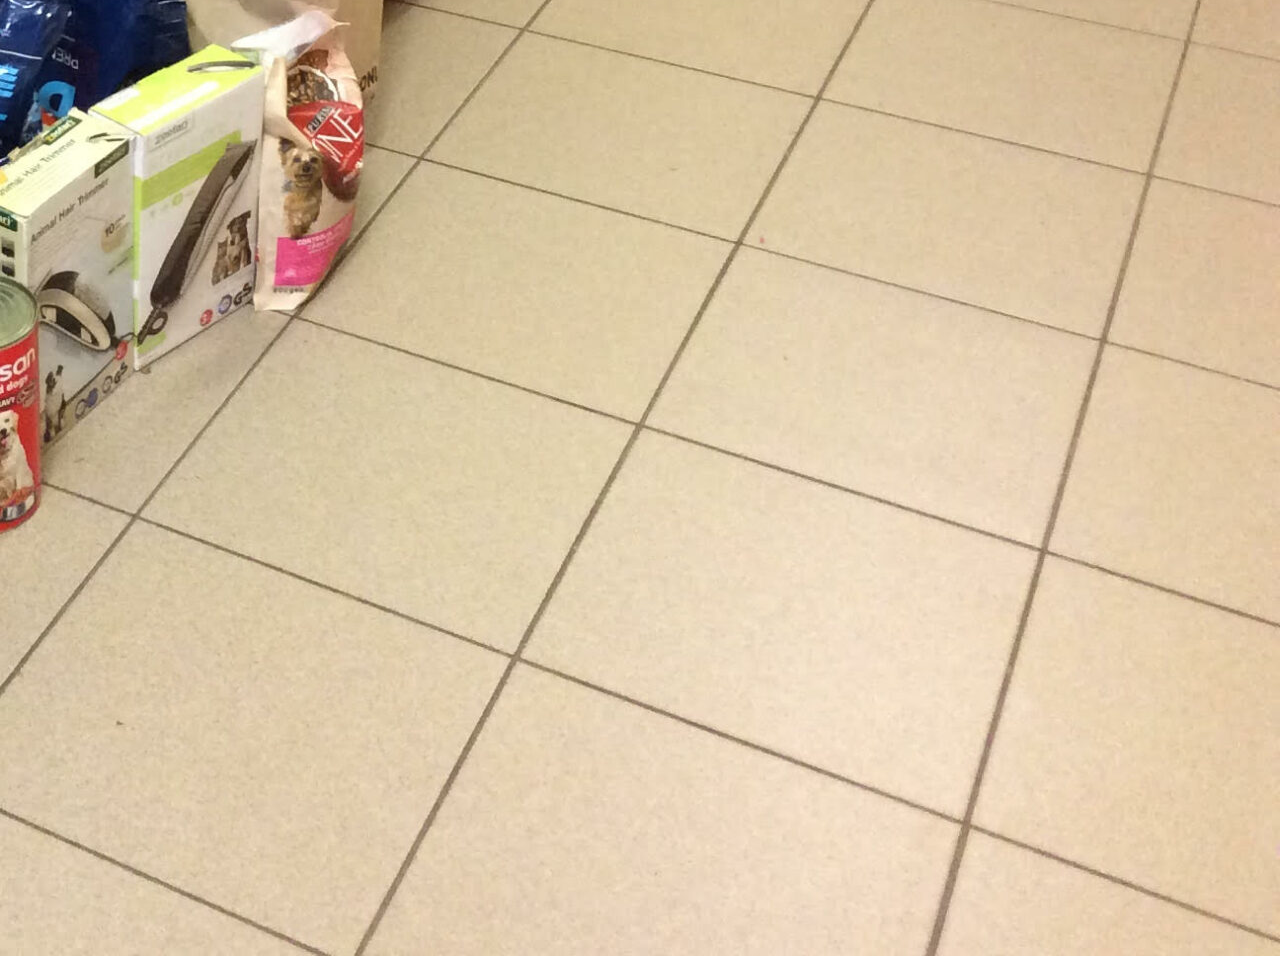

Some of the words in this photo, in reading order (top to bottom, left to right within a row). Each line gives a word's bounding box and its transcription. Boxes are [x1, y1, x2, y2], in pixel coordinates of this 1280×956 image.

[31, 216, 57, 244] Animal
[58, 201, 76, 222] Hair
[77, 178, 109, 206] Trimmer
[6, 375, 29, 392] dogs
